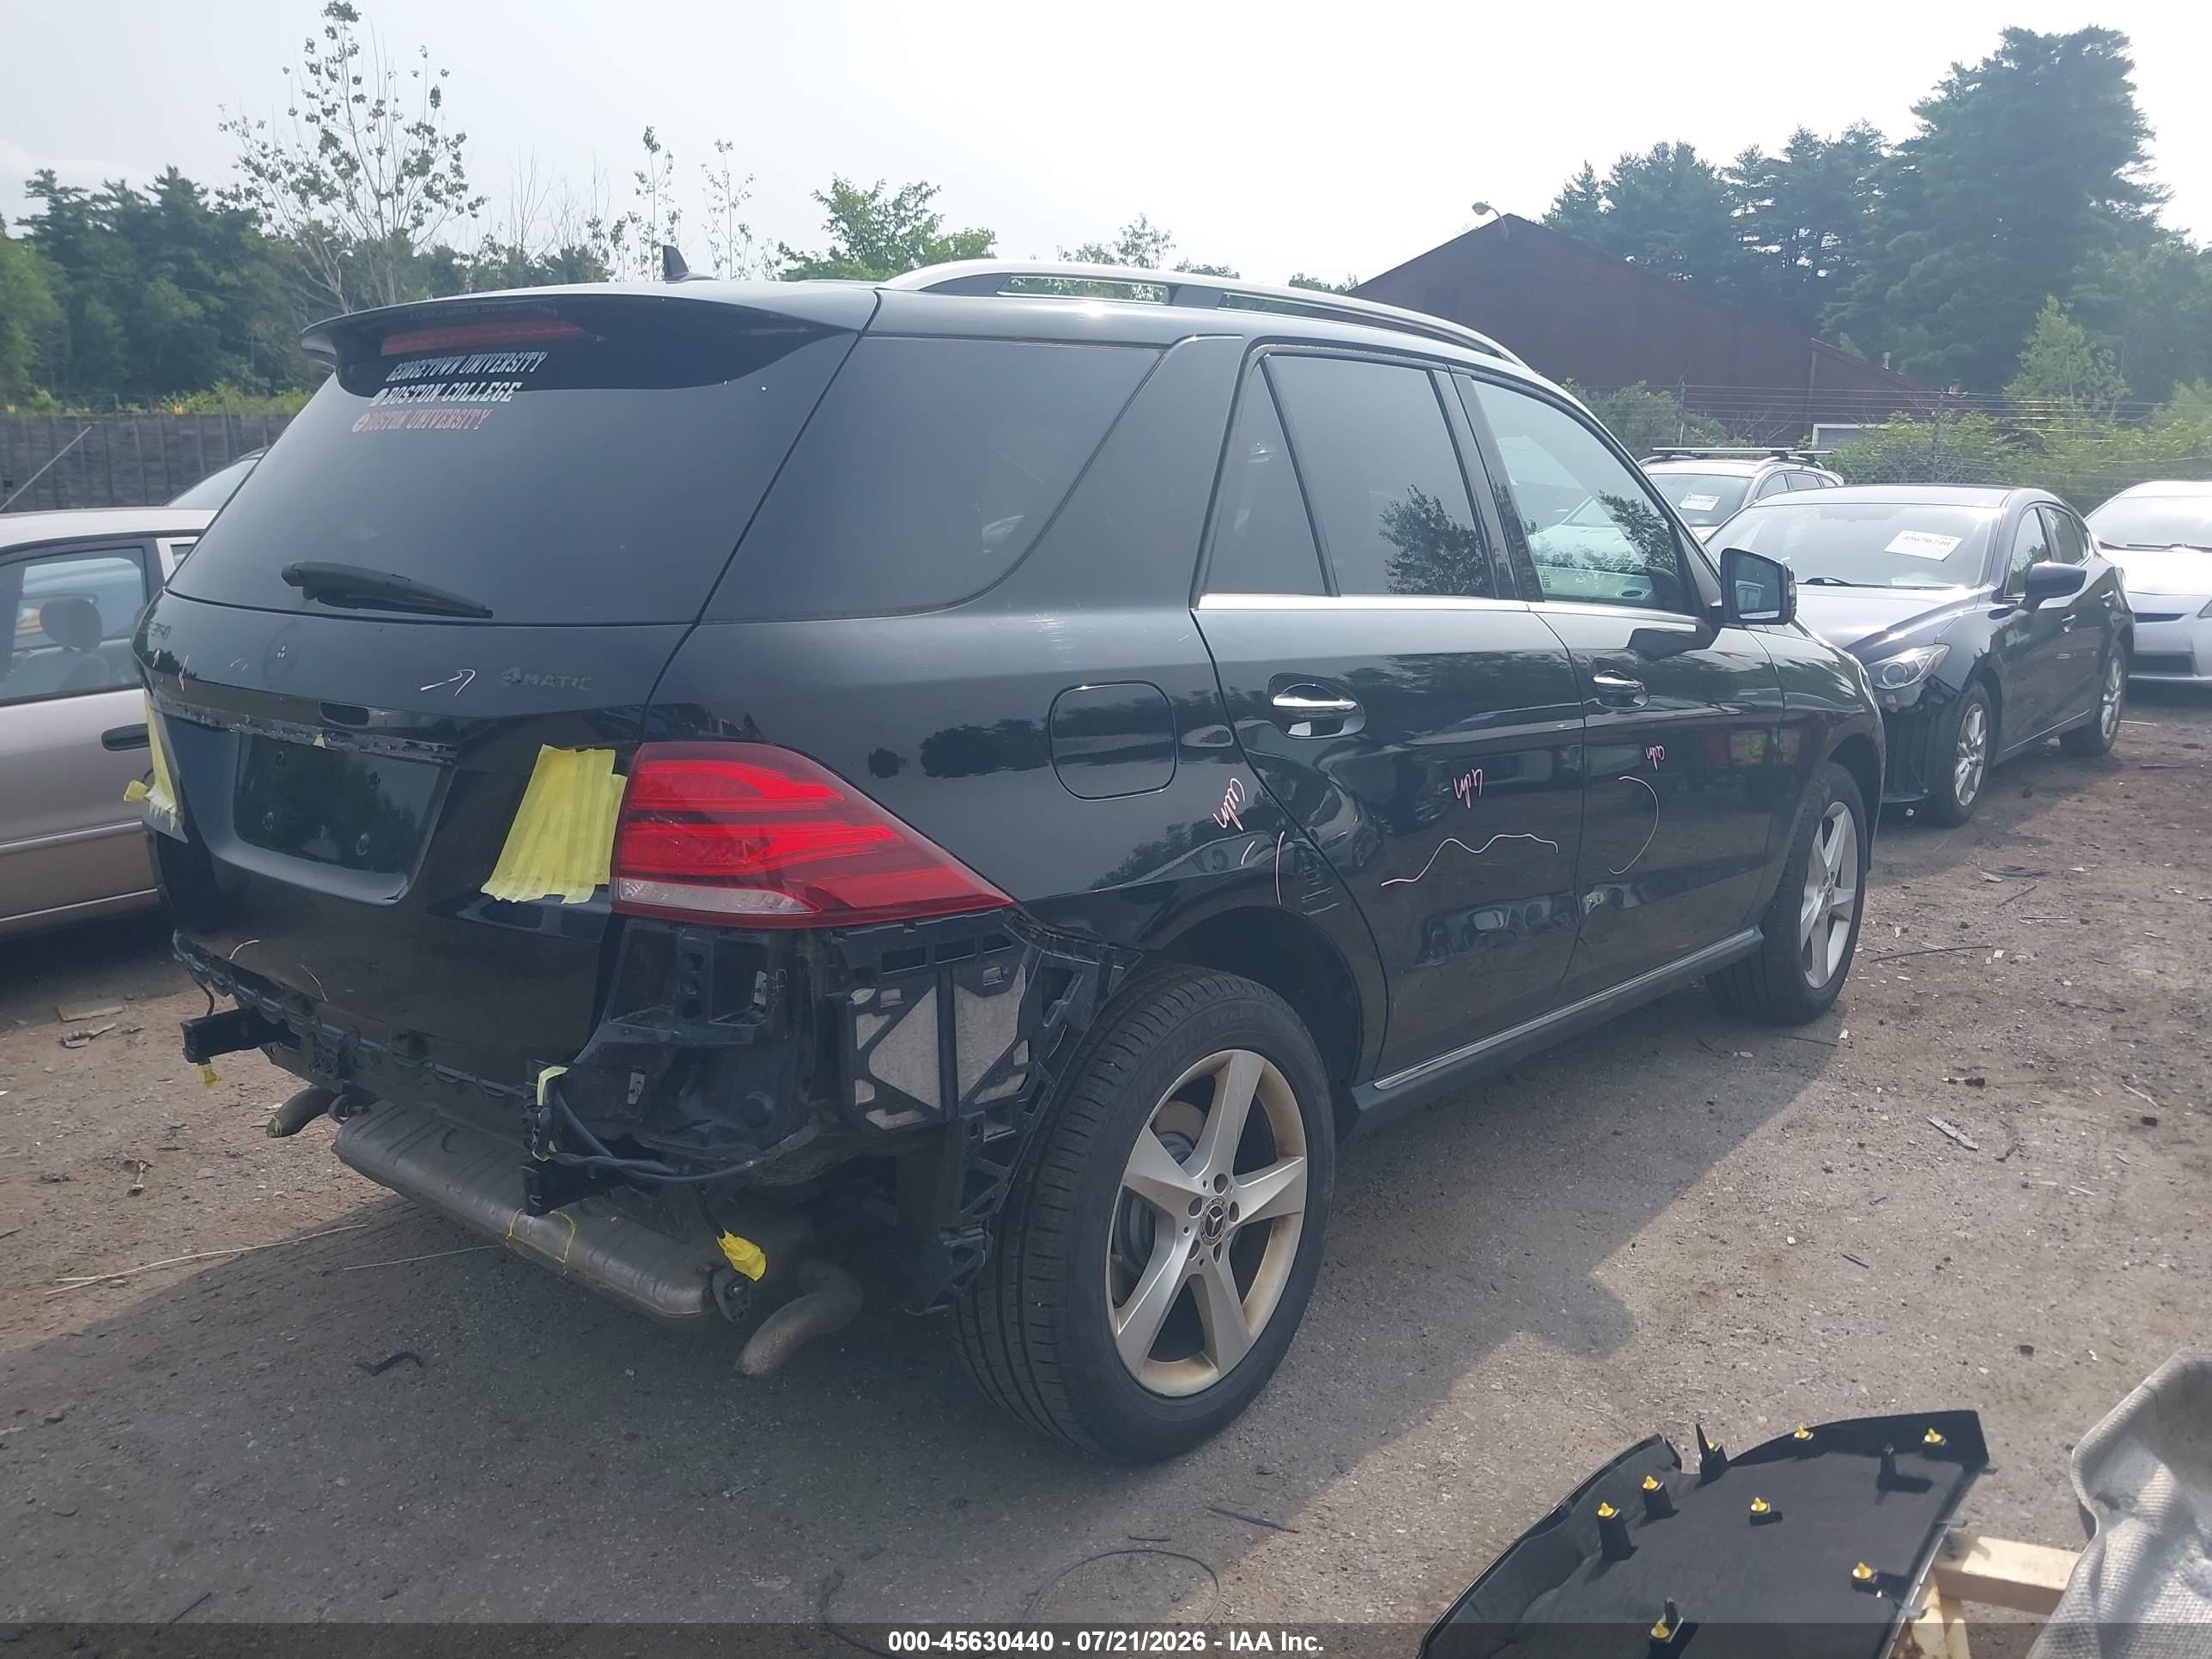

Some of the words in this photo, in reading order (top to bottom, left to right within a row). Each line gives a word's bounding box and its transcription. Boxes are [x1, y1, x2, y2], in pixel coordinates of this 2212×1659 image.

[386, 356, 466, 382] GEORGETOWN
[459, 350, 549, 375] UNIVERSITY
[380, 383, 447, 406] BOSTON
[441, 382, 522, 403] COLLEGE
[405, 408, 494, 430] UNIVERSITY
